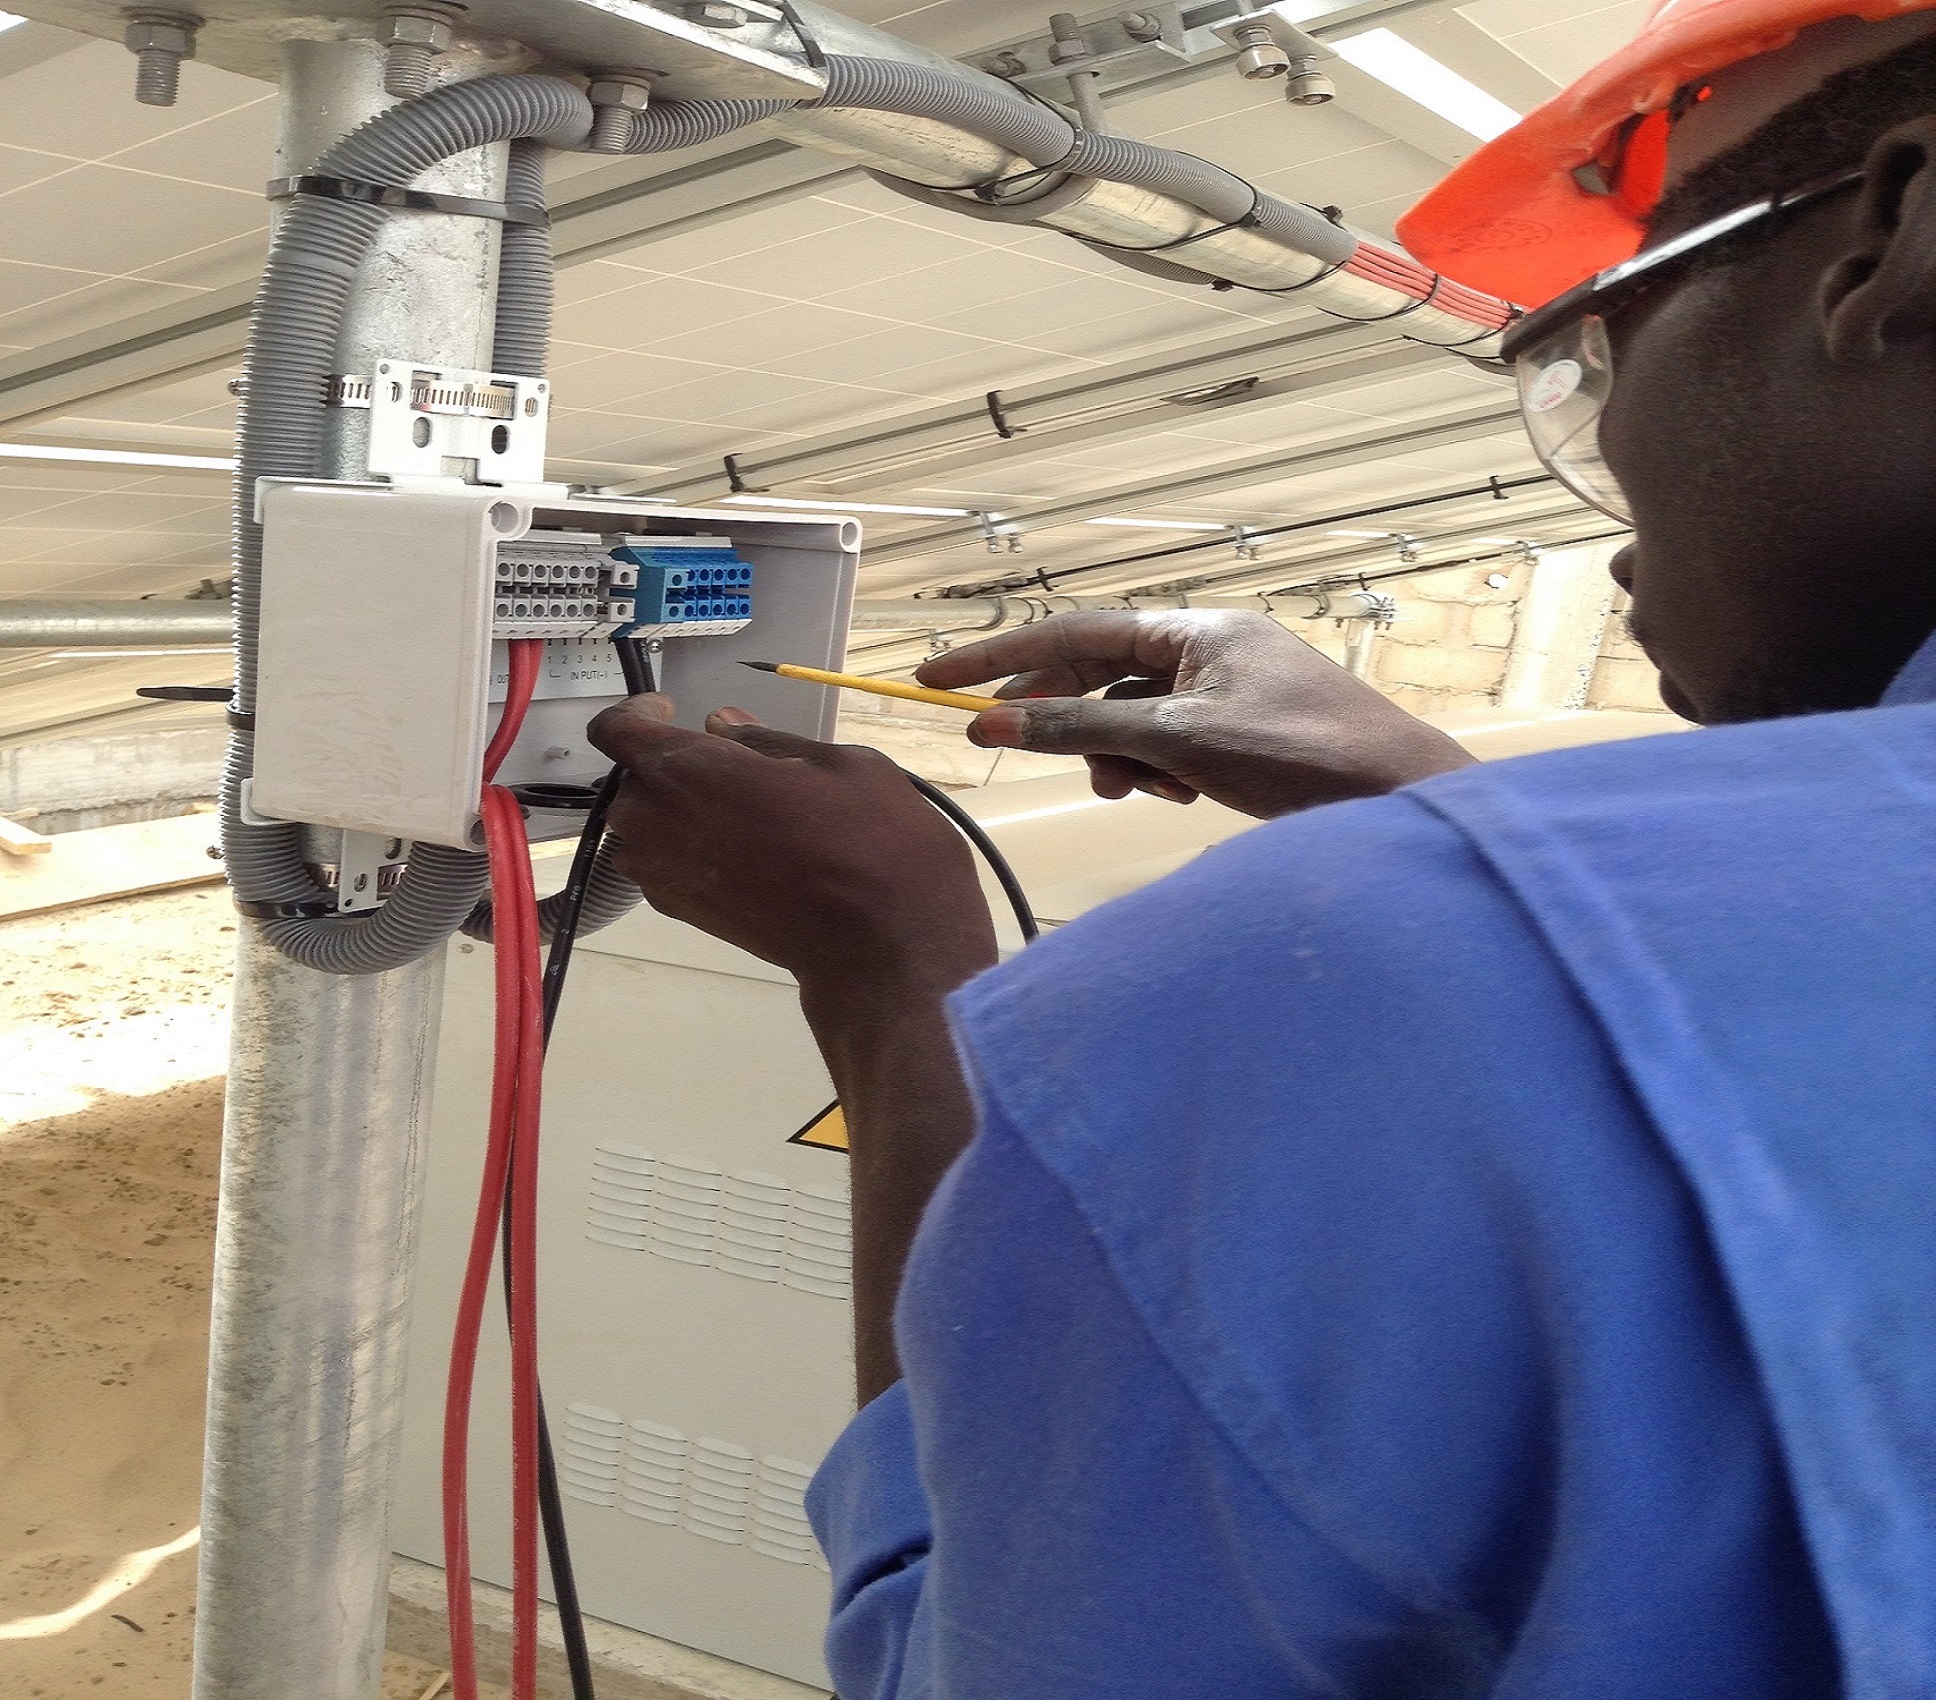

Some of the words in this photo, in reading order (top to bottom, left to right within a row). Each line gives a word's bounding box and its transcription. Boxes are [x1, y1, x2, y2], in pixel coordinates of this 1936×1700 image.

[562, 655, 568, 664] 2
[577, 655, 583, 663] 3
[592, 654, 597, 662] 4
[606, 654, 612, 662] 5
